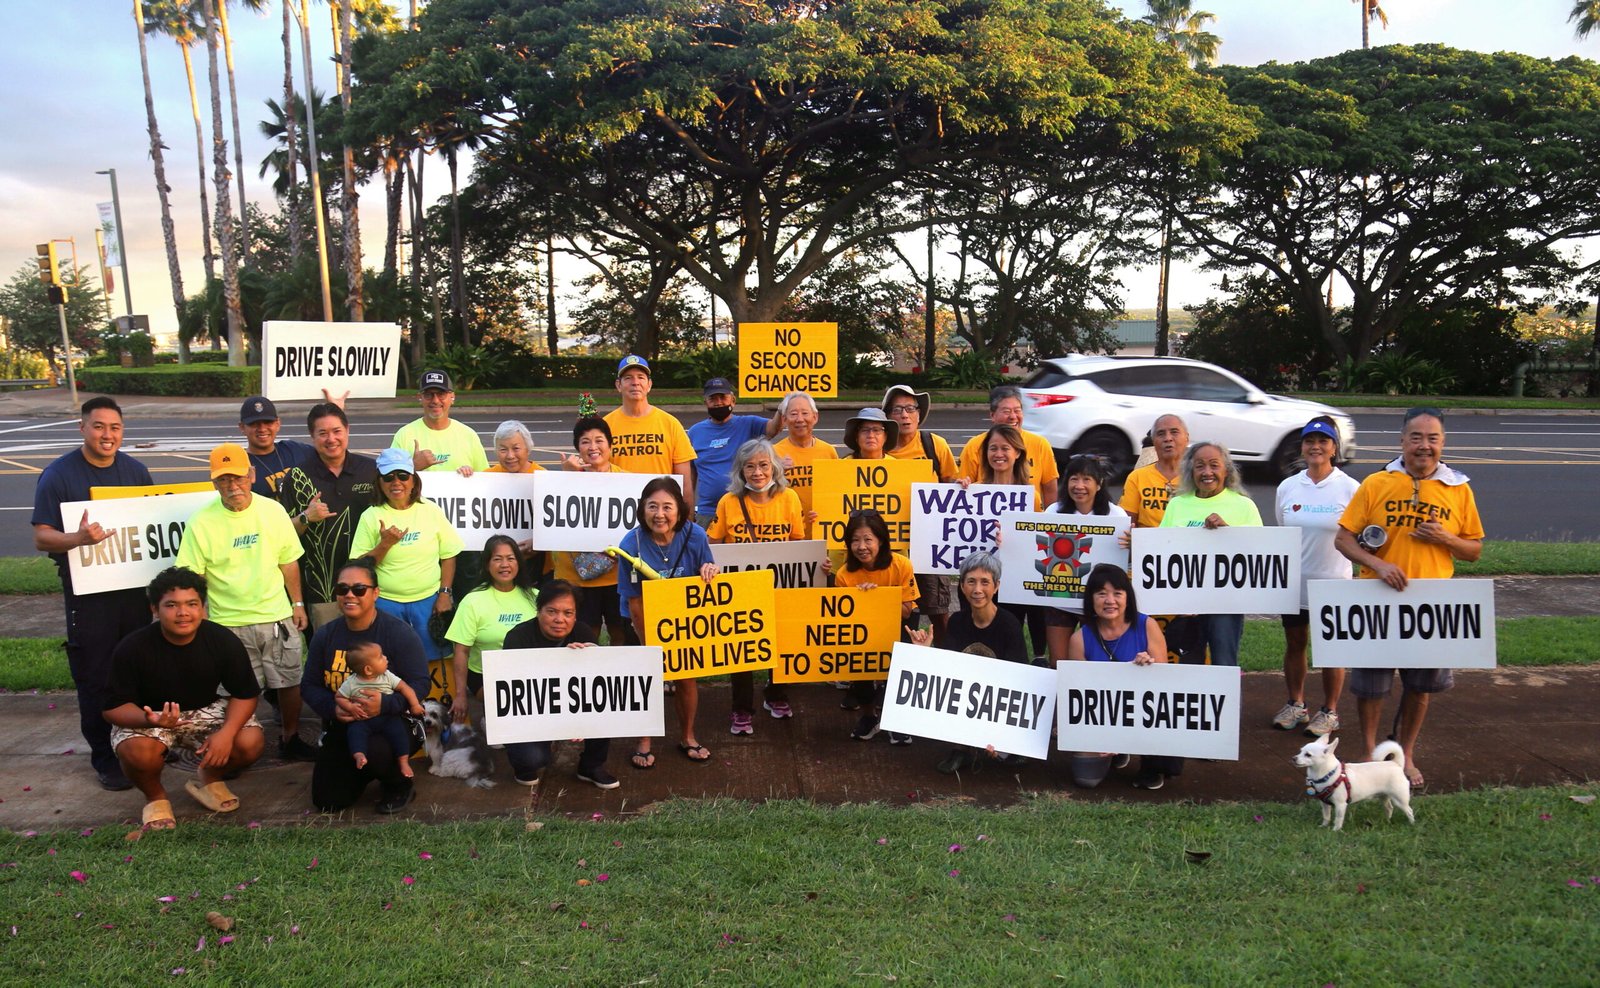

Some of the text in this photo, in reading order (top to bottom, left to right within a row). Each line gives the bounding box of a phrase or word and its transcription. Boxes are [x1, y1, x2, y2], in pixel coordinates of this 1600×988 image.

[775, 328, 801, 347] NO
[275, 346, 391, 378] DRIVE SLOWLY
[750, 351, 826, 369] SECOND
[745, 374, 831, 392] CHANCES
[610, 433, 664, 446] CITIZEN
[612, 445, 662, 458] PATROL
[856, 465, 888, 488] NO
[543, 494, 641, 530] SLOW DO
[918, 489, 1028, 516] WATCH
[232, 533, 260, 548] WAVE
[942, 517, 1000, 543] FOR
[1016, 522, 1035, 531] IT'S
[1037, 524, 1056, 532] NOT
[1081, 527, 1115, 535] RIGHT
[1043, 575, 1081, 584] TO RUN
[1142, 553, 1290, 590] SLOW DOWN
[685, 582, 733, 609] BAD
[1023, 582, 1086, 593] THE RED LIG
[498, 612, 523, 622] WAVE
[821, 594, 855, 618] NO
[657, 609, 764, 643] CHOICES
[1320, 603, 1481, 640] SLOW DOWN
[806, 624, 868, 646] NEED
[711, 638, 772, 667] LIVES
[780, 651, 892, 675] TO SPEED
[495, 675, 653, 718] DRIVE SLOWLY
[895, 669, 1047, 730] DRIVE SAFELY
[1068, 688, 1226, 731] DRIVE SAFELY
